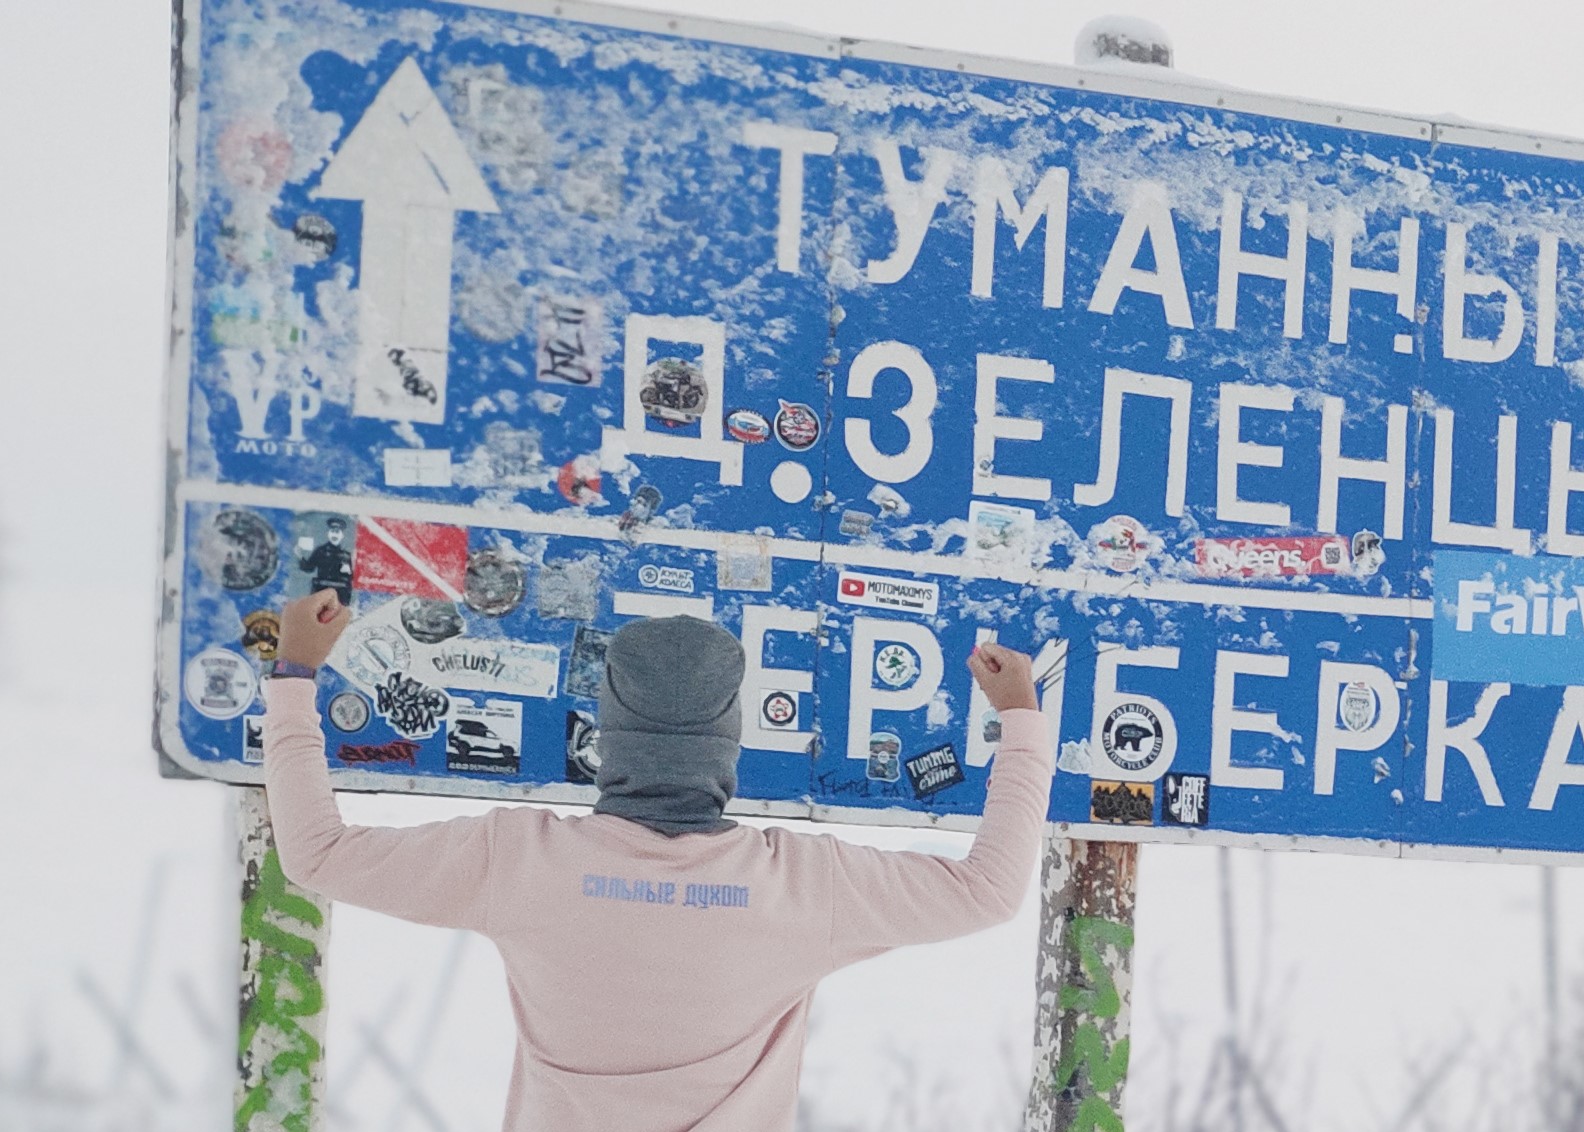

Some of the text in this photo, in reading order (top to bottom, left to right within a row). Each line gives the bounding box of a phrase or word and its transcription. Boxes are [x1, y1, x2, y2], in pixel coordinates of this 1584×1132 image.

[234, 439, 317, 459] MOTO
[1110, 704, 1157, 725] PATRIOTS
[906, 746, 956, 779] TUNING
